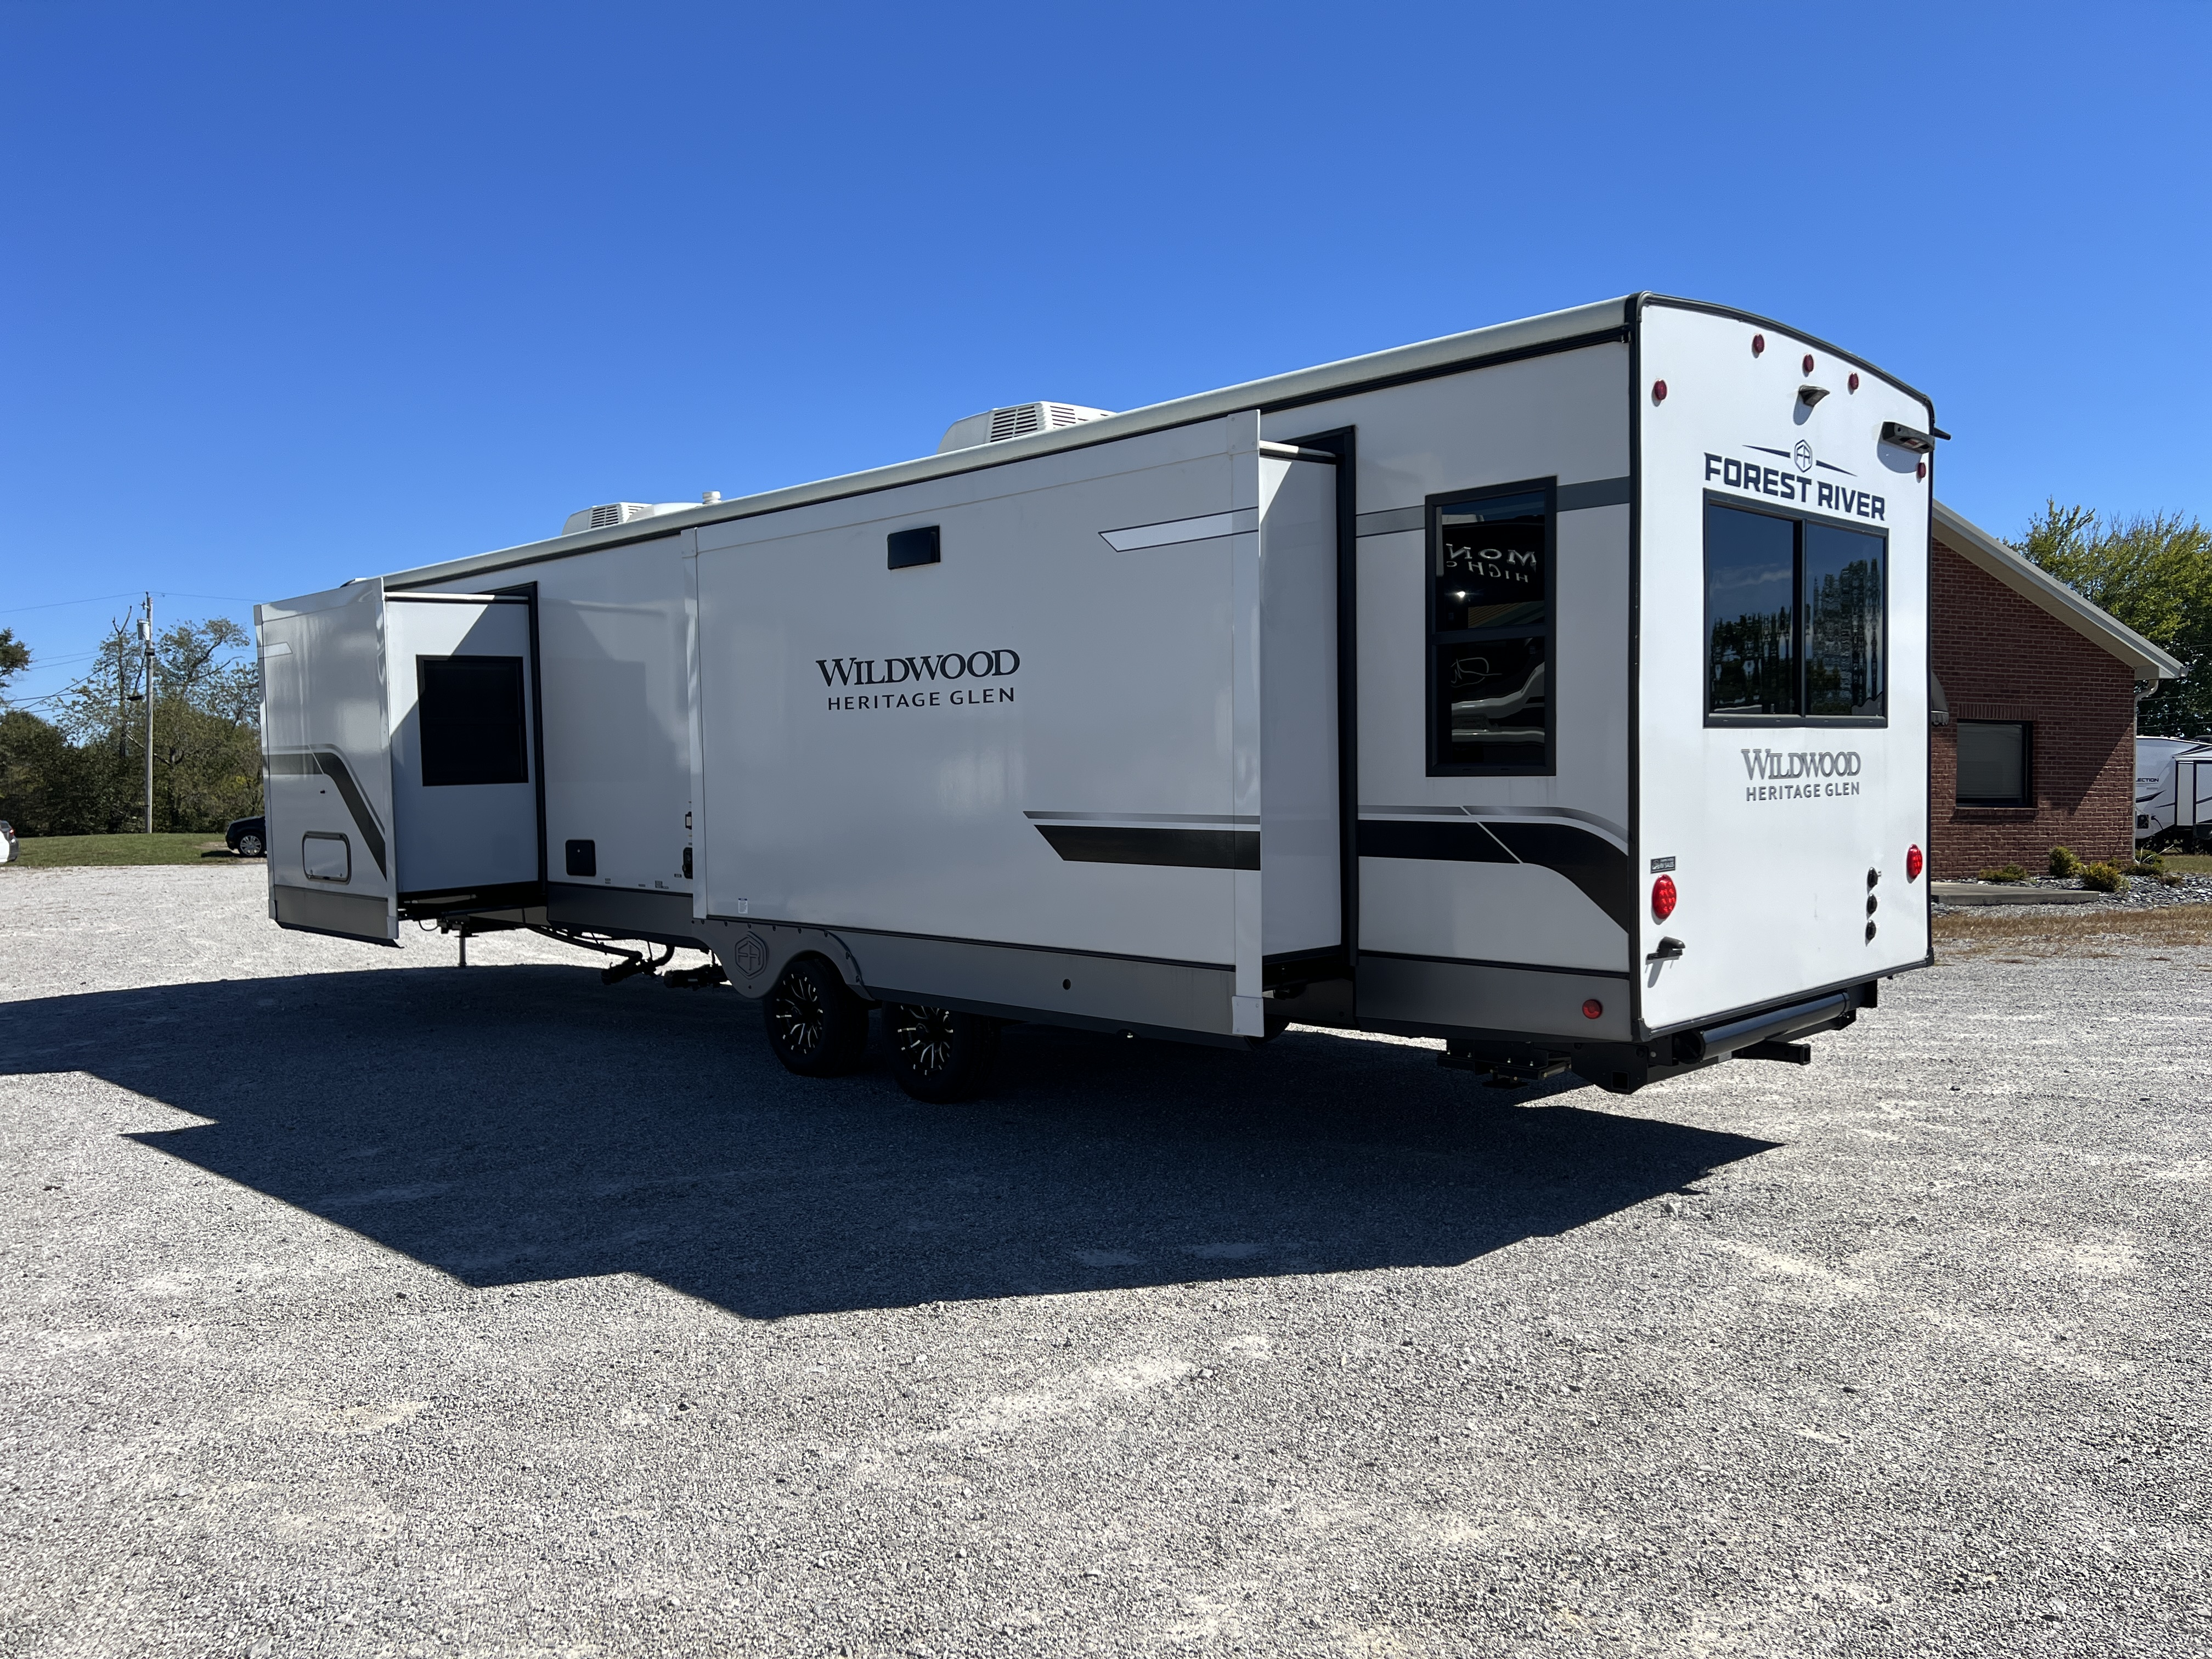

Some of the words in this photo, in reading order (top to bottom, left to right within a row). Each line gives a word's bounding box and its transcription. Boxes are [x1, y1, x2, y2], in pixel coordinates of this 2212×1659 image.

[1703, 452, 1812, 503] FOREST
[1817, 481, 1885, 521] RIVER
[815, 649, 1020, 687] WILDWOOD
[828, 692, 940, 710] HERITAGE
[950, 687, 1014, 705] GLEN
[1741, 748, 1861, 781] WILDWOOD
[1746, 783, 1821, 802] HERITAGE
[1825, 781, 1860, 797] GLEN
